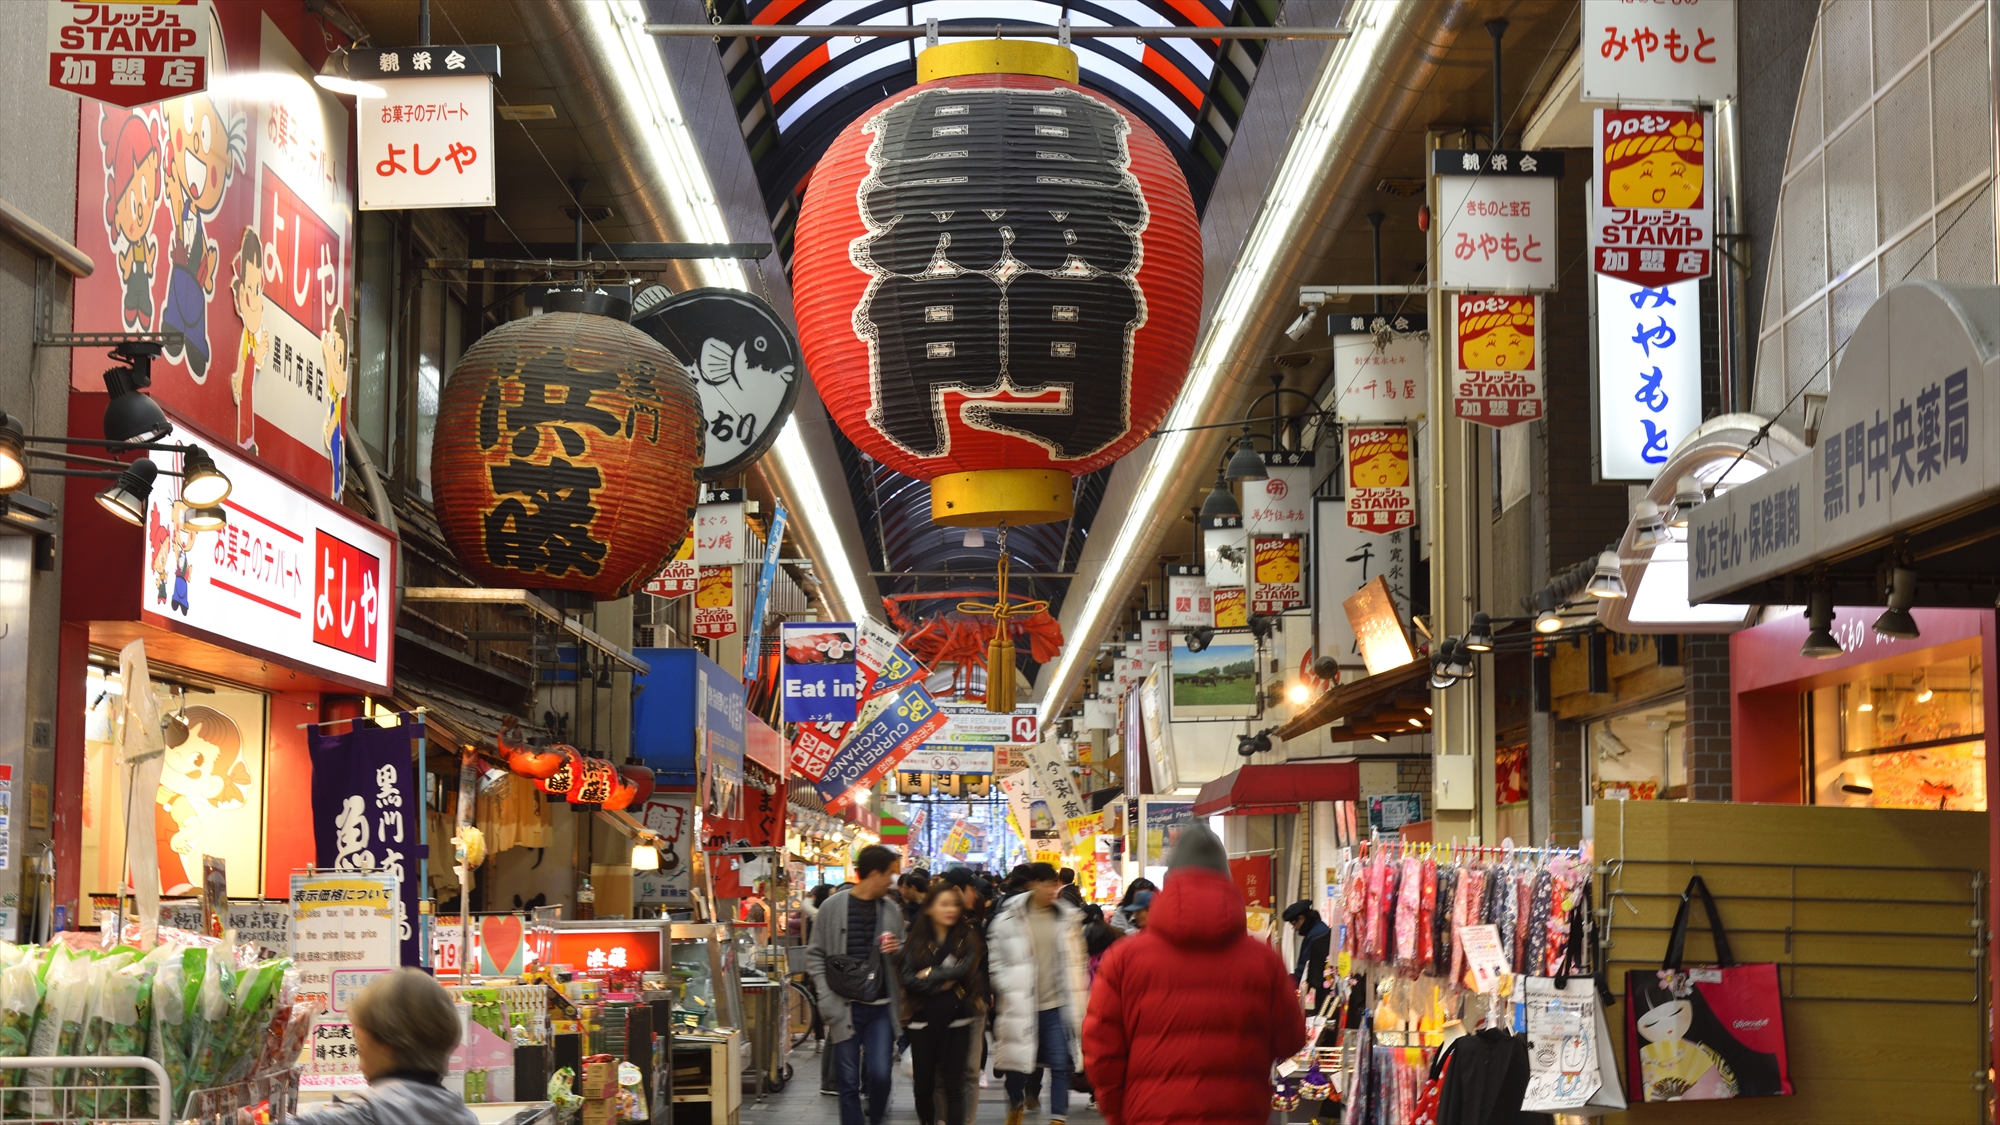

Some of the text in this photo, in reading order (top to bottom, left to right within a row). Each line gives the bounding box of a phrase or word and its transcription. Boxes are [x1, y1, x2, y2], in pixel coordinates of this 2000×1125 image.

[73, 4, 181, 27] フレッシュ
[60, 27, 196, 52] STAMP
[1601, 27, 1717, 63] みやもと
[379, 51, 467, 72] 親栄会
[60, 56, 196, 87] 加盟店
[380, 102, 469, 123] お菓子のデパート
[1606, 117, 1670, 140] クロモン
[376, 142, 478, 178] よしや
[1462, 153, 1537, 172] 親栄会
[1466, 201, 1531, 217] きものと宝石
[1611, 210, 1692, 226] フレッシュ
[1602, 226, 1703, 246] STAMP
[1455, 232, 1542, 263] みやもと
[263, 191, 338, 330] よしや
[1602, 249, 1702, 273] 加盟店
[1460, 297, 1509, 317] クロモン
[272, 335, 324, 403] 黒門市場店
[1465, 371, 1526, 383] フレッシュ
[1630, 287, 1677, 464] みやもと
[1459, 383, 1536, 398] STAMP
[1460, 400, 1537, 418] 加盟店
[1350, 431, 1388, 447] クロモン
[1823, 367, 1970, 523] 黒門中央薬局
[1355, 488, 1403, 498] フレッシュ
[1351, 498, 1410, 510] STAMP
[1351, 511, 1410, 525] 加盟店
[1255, 541, 1285, 552] クロモン
[213, 522, 302, 598] お菓子のデパート
[658, 568, 695, 578] TAMP
[647, 580, 696, 592] 加盟店
[1255, 590, 1300, 600] STAMP
[1258, 583, 1294, 591] フレッシュ
[316, 546, 378, 649] よしや
[1214, 591, 1239, 602] クロモン
[695, 614, 734, 623] STAMP
[696, 624, 735, 633] 加盟店
[786, 679, 826, 698] Eat
[833, 679, 855, 697] in
[822, 721, 888, 782] EXCHANGE
[841, 722, 909, 786] CURRENCY
[293, 888, 393, 902] 表示価格について
[660, 888, 688, 897] 新魚栄
[327, 908, 338, 917] tax
[359, 908, 368, 917] be
[306, 930, 317, 939] the
[322, 931, 339, 941] price
[344, 930, 355, 940] tag
[361, 930, 377, 939] price
